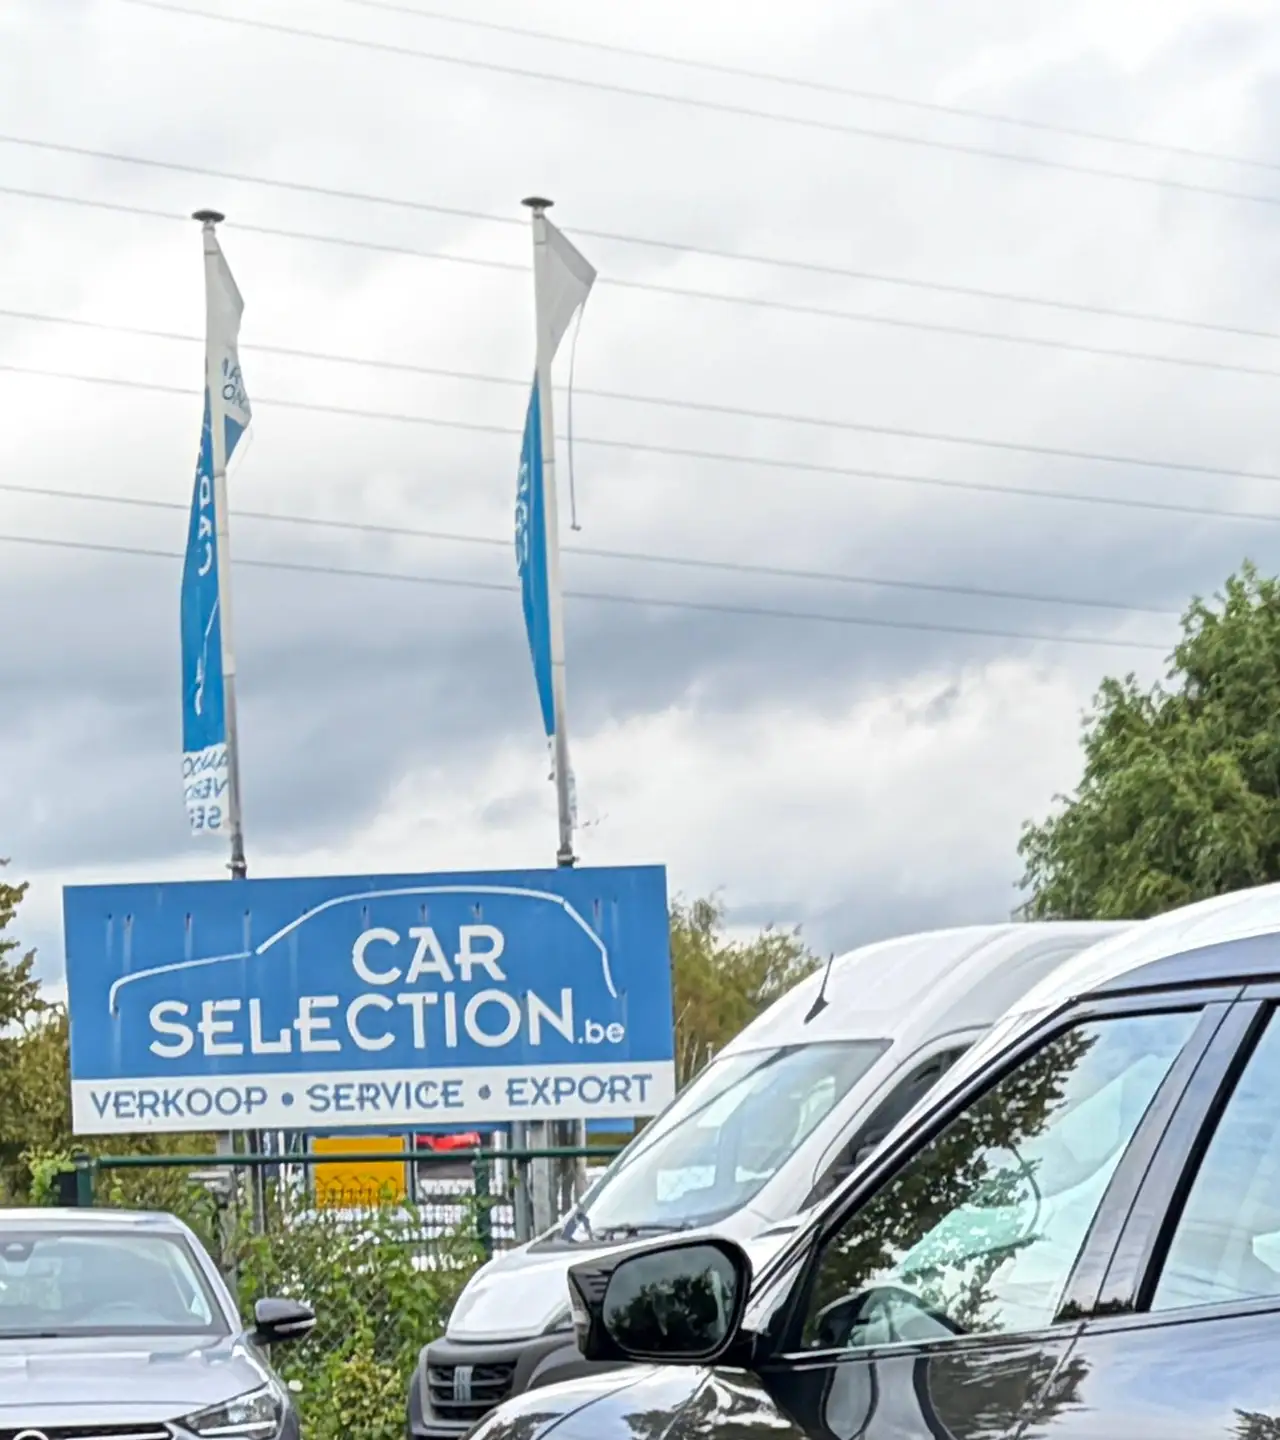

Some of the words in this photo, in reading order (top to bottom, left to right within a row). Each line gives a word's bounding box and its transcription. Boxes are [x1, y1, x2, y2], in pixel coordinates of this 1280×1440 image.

[351, 924, 506, 985] CAR
[90, 1085, 268, 1119] VERKOOP
[307, 1080, 464, 1113] SERVICE
[505, 1073, 653, 1107] EXPORT
